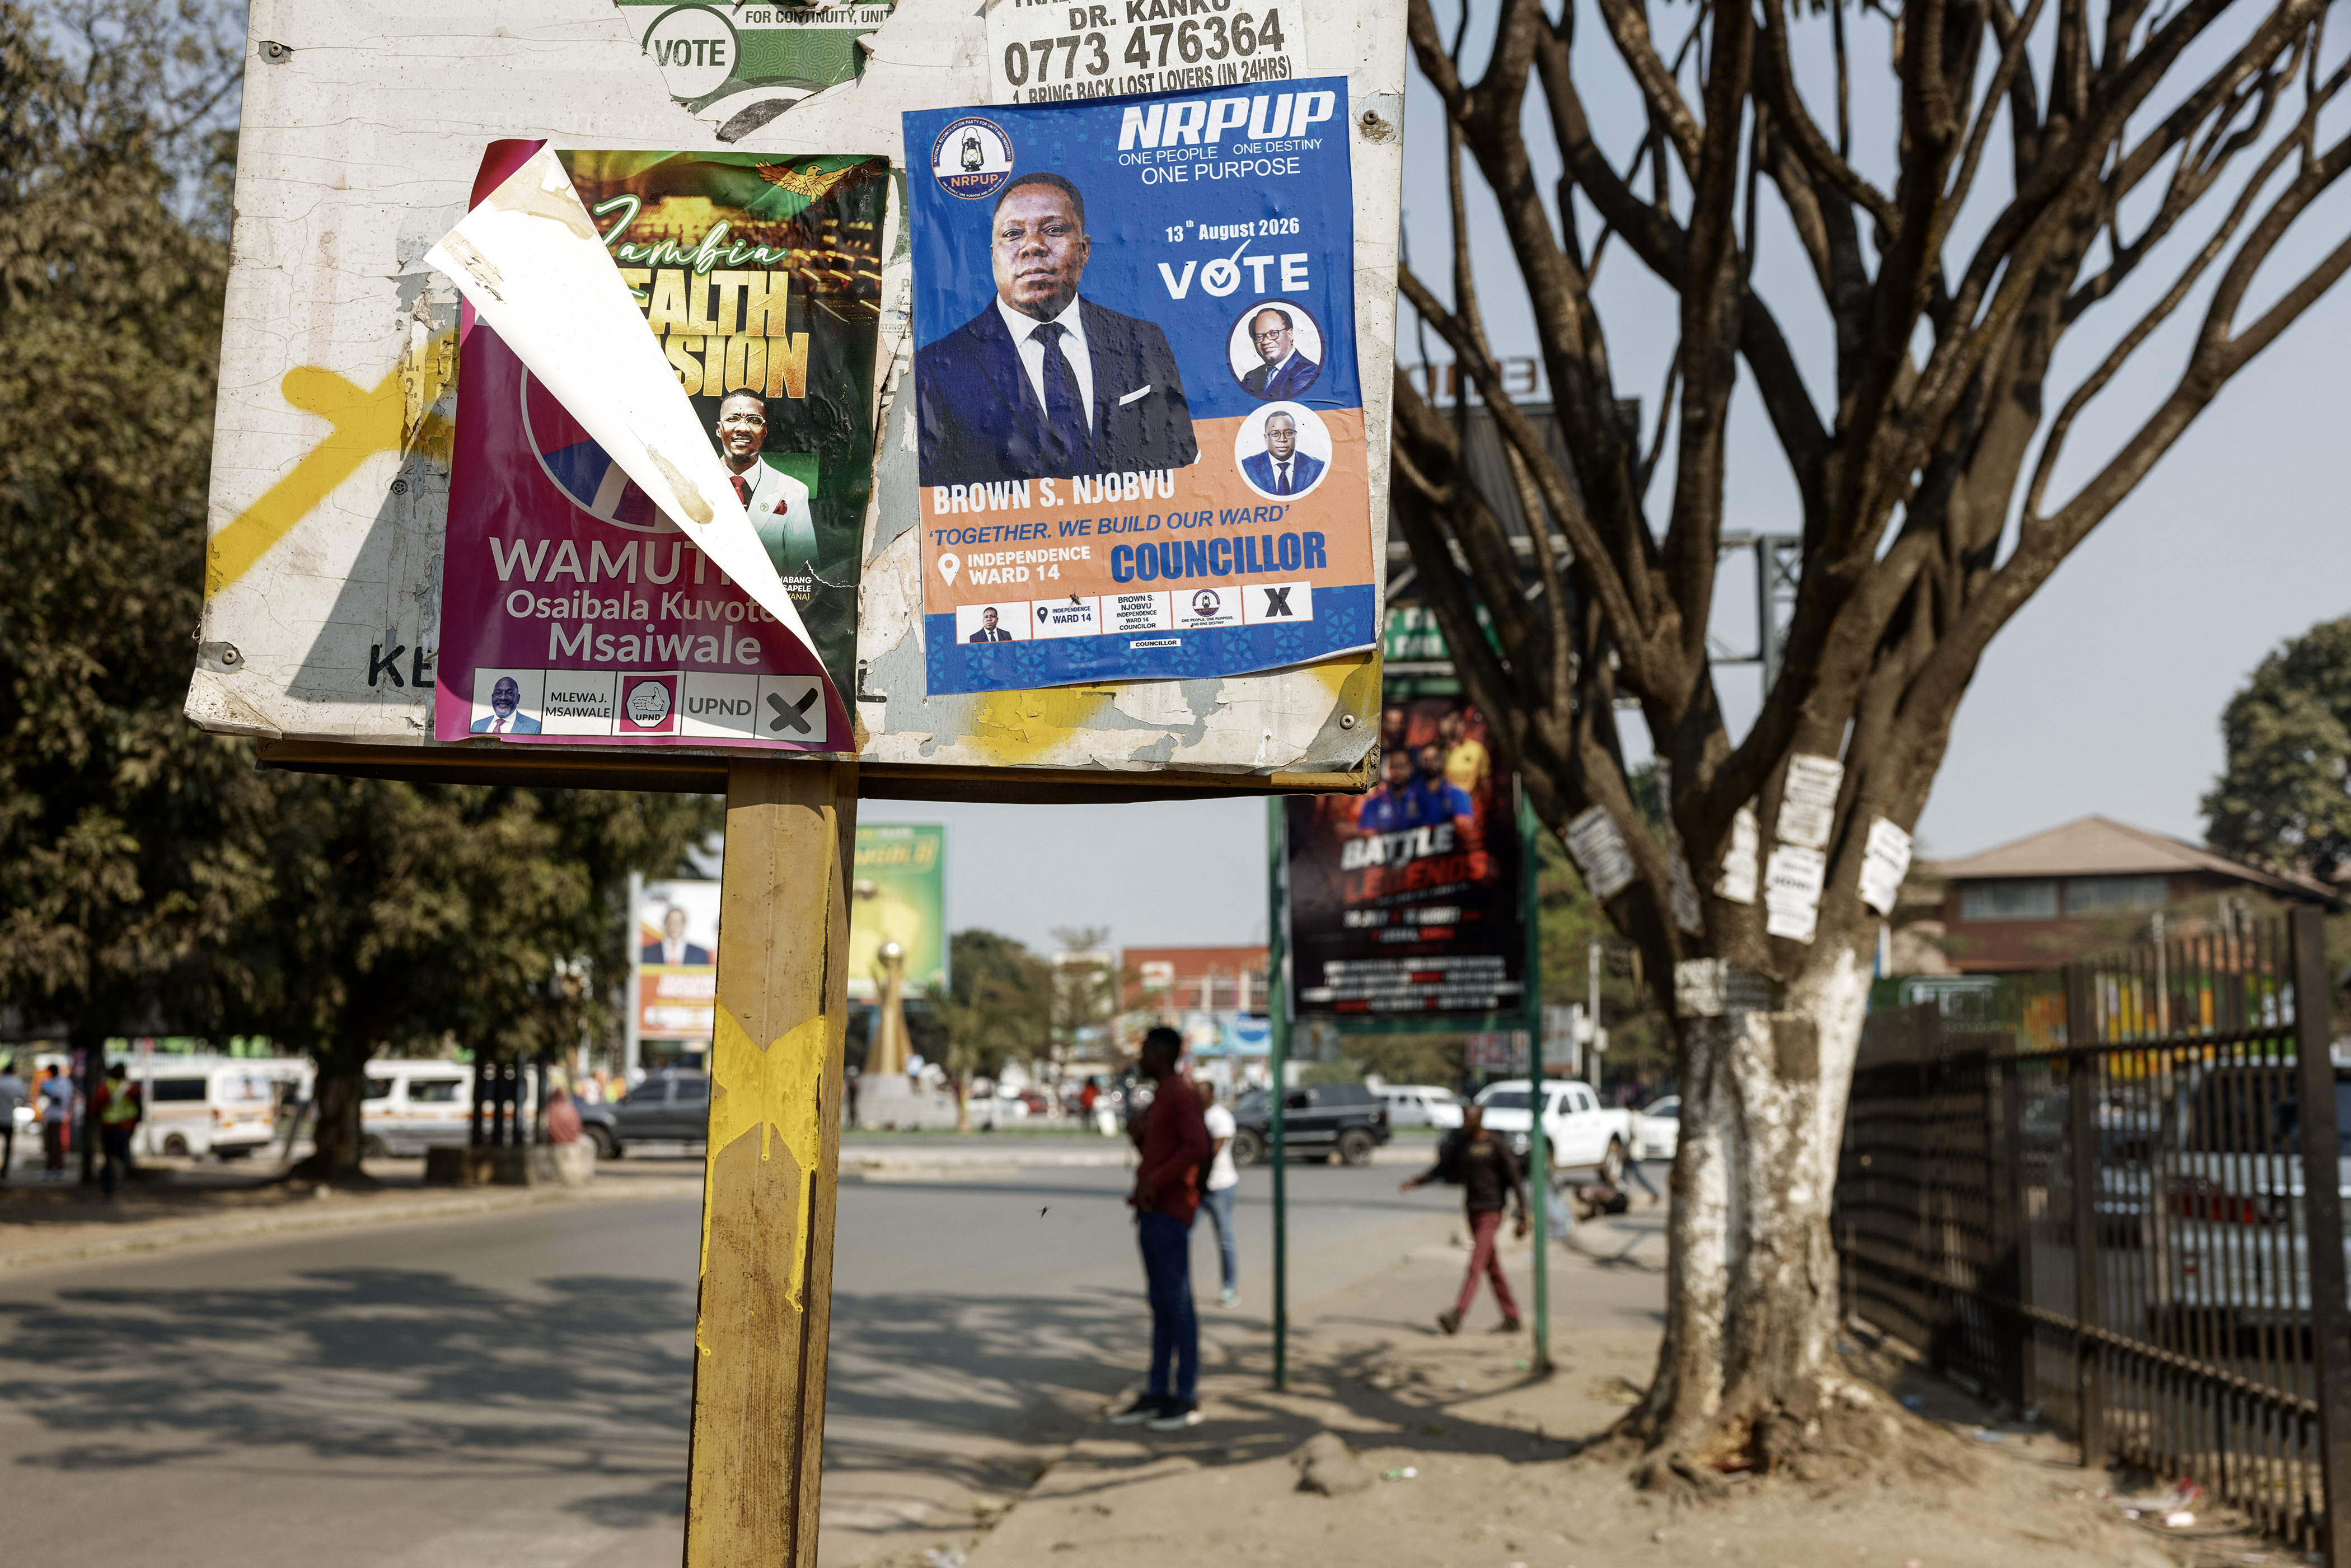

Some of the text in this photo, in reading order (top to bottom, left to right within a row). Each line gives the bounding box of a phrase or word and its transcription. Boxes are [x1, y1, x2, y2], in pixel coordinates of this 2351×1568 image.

[746, 11, 771, 23] FOR
[776, 10, 857, 25] CONTINUITY,
[1069, 5, 1116, 31] DR.
[654, 39, 725, 67] VOTE
[1005, 8, 1284, 86] 0773 476364
[1029, 85, 1073, 103] BRING
[1077, 78, 1114, 99] BACK
[1119, 73, 1154, 95] LOST
[1159, 65, 1214, 91] LOVERS
[1217, 62, 1238, 85] (IN
[1241, 55, 1292, 83] 24HRS)
[1117, 91, 1336, 151] NRPUP
[939, 122, 965, 143] RECONCILIATION
[1003, 137, 1011, 161] PROSPERITY
[1119, 138, 1323, 166] ONE PEOPLE ONE DESTINY
[950, 174, 999, 188] NRPUP
[1141, 157, 1301, 185] ONE PURPOSE
[593, 194, 788, 276] Zambia
[1198, 222, 1256, 241] August
[1259, 217, 1299, 236] 2026
[1158, 252, 1309, 299] VOTE
[656, 330, 809, 399] SION
[934, 469, 1174, 514] BROWN S. NJOBVU
[1059, 519, 1092, 537] WE
[1097, 514, 1161, 535] BUILD
[1167, 510, 1214, 530] OUR
[489, 537, 731, 586] WAMUT
[968, 546, 1091, 568] INDEPENDENCE
[1111, 531, 1327, 583] COUNCILLOR
[969, 564, 1060, 586] WARD 14
[506, 589, 777, 622] Osaibala Kuvote
[1053, 614, 1092, 624] WARD 14
[1117, 610, 1157, 618] INDEPENDENCE
[1119, 622, 1156, 631] COUNCILOR
[549, 622, 761, 665] Msaiwale
[551, 691, 607, 704] MLEWA J.
[689, 697, 752, 716] UPND
[545, 706, 611, 718] MSAIWALE
[635, 713, 661, 721] UPND
[1340, 822, 1454, 871] BATTLE
